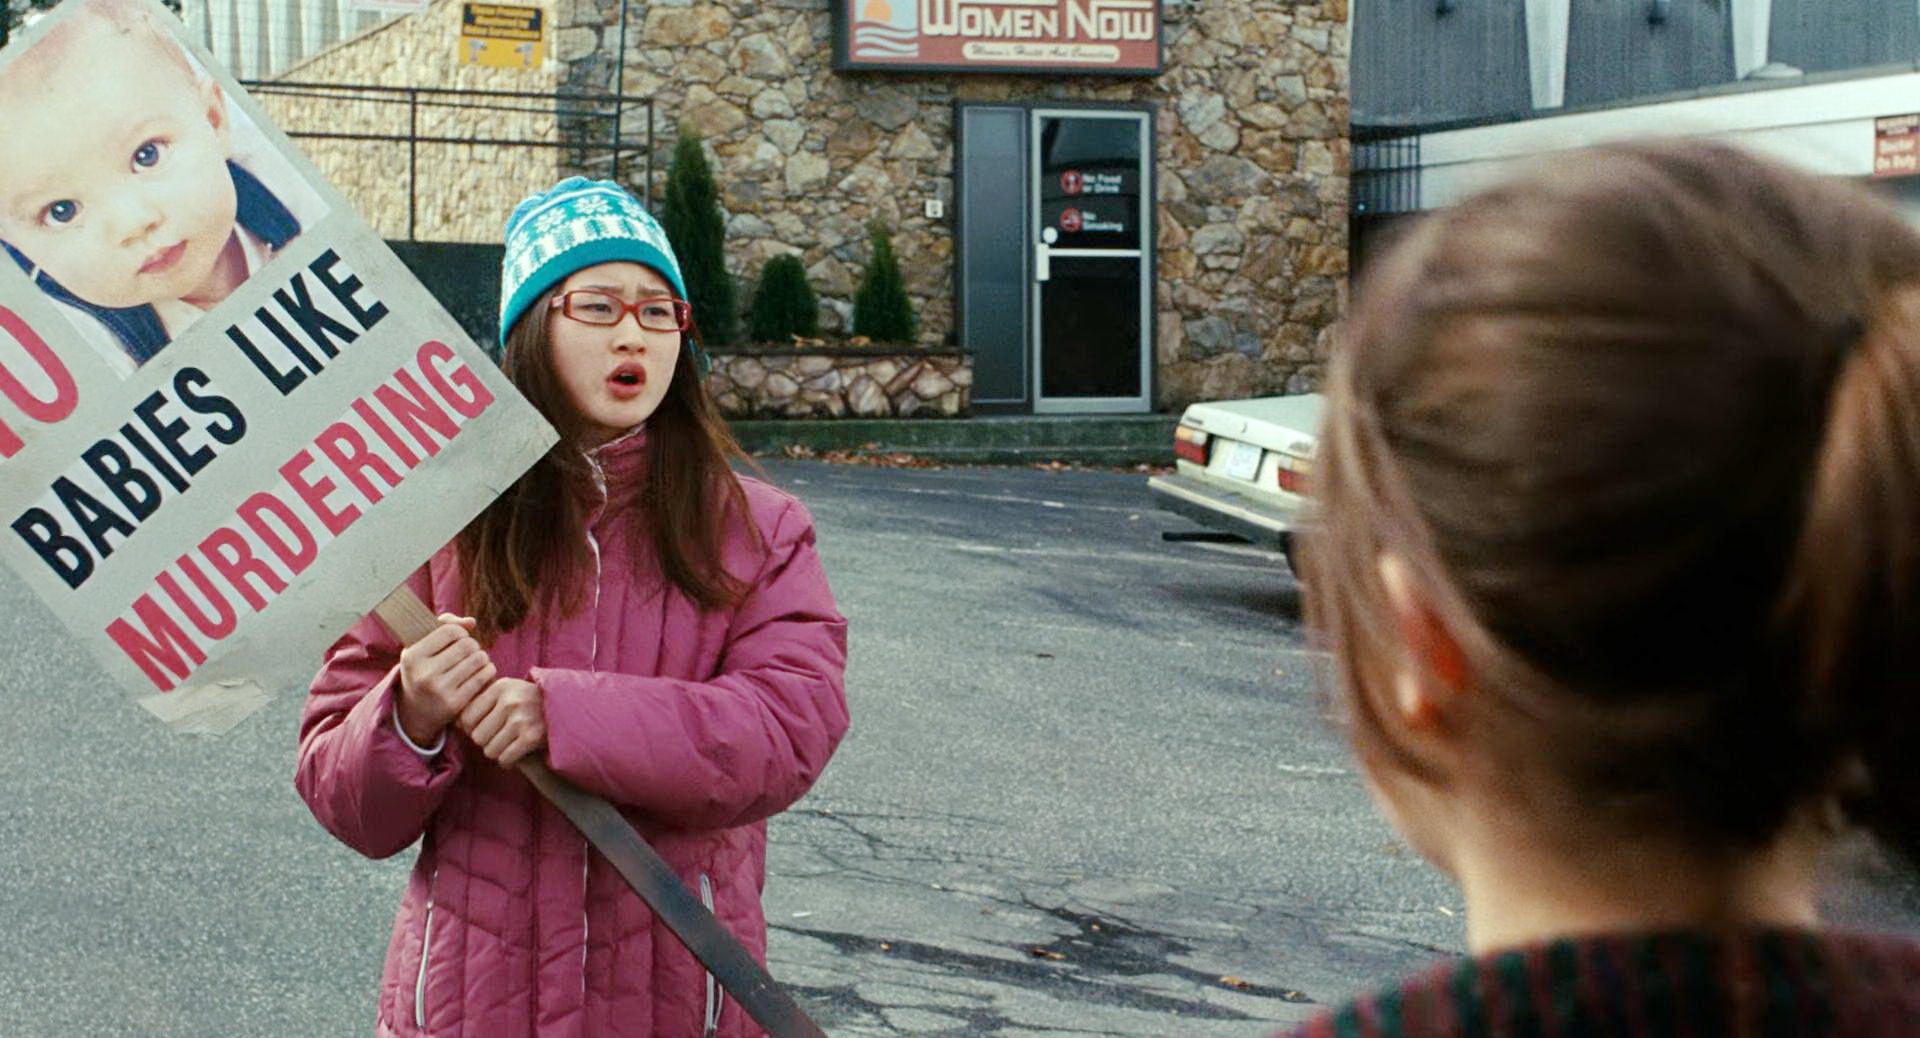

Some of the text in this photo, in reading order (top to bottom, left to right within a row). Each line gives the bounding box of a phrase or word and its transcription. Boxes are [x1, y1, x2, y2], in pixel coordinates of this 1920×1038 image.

[10, 248, 390, 590] BABIES LIKE
[105, 340, 495, 693] MURDERING
